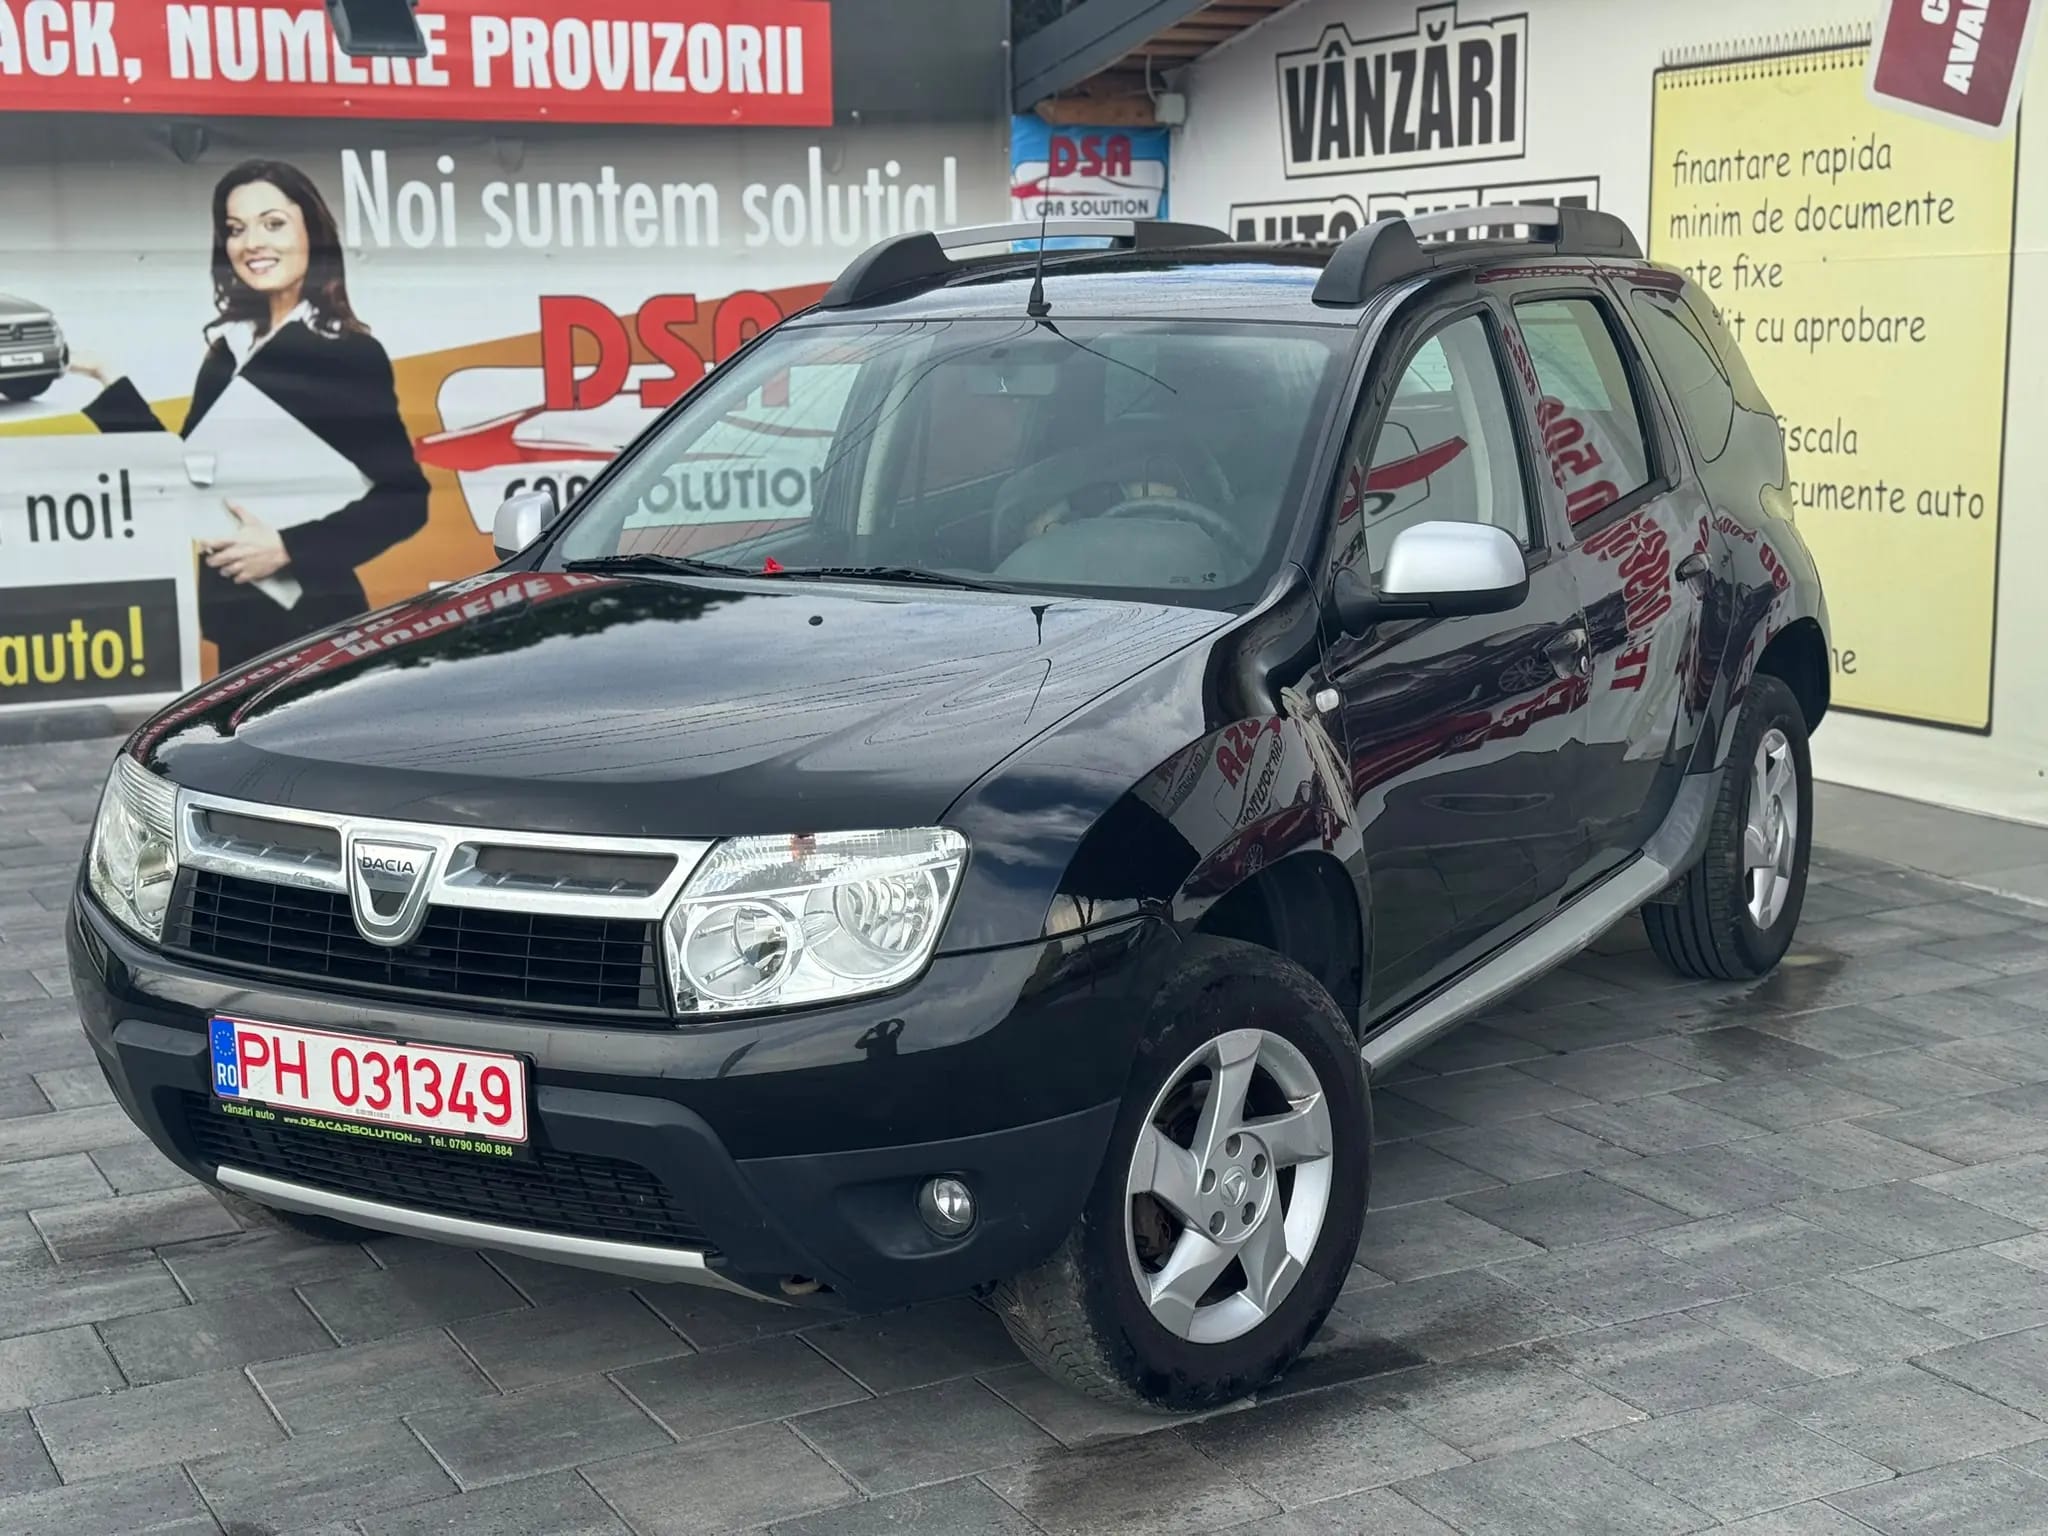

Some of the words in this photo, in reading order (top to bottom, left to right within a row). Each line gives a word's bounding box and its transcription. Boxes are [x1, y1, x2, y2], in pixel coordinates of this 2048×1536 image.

[471, 15, 803, 95] PROVIZORII
[1285, 22, 1519, 163] VÂNZĂRI
[1049, 133, 1132, 177] DSA
[1672, 149, 1791, 188] finantare
[1801, 132, 1892, 186] rapida
[341, 148, 456, 248] Noi
[483, 165, 720, 249] suntem
[1036, 200, 1065, 217] CAR
[1072, 200, 1149, 217] SOLUTION
[1670, 203, 1742, 240] minim
[1752, 198, 1784, 235] de
[1794, 191, 1955, 232] documente
[1733, 252, 1783, 291] fixe
[539, 289, 790, 410] DSA
[1756, 316, 1784, 343] cu
[1794, 306, 1927, 354] aprobare
[27, 468, 135, 541] noi!
[1917, 484, 1985, 519] auto
[0, 605, 146, 686] auto!
[361, 856, 415, 874] DACIA
[216, 1062, 237, 1088] RO
[237, 1031, 309, 1100] PH
[330, 1047, 513, 1127] 031349
[255, 1108, 276, 1121] auto
[428, 1135, 447, 1148] Tel.
[449, 1138, 473, 1152] 0790
[474, 1141, 493, 1154] 500
[494, 1144, 514, 1158] 884
